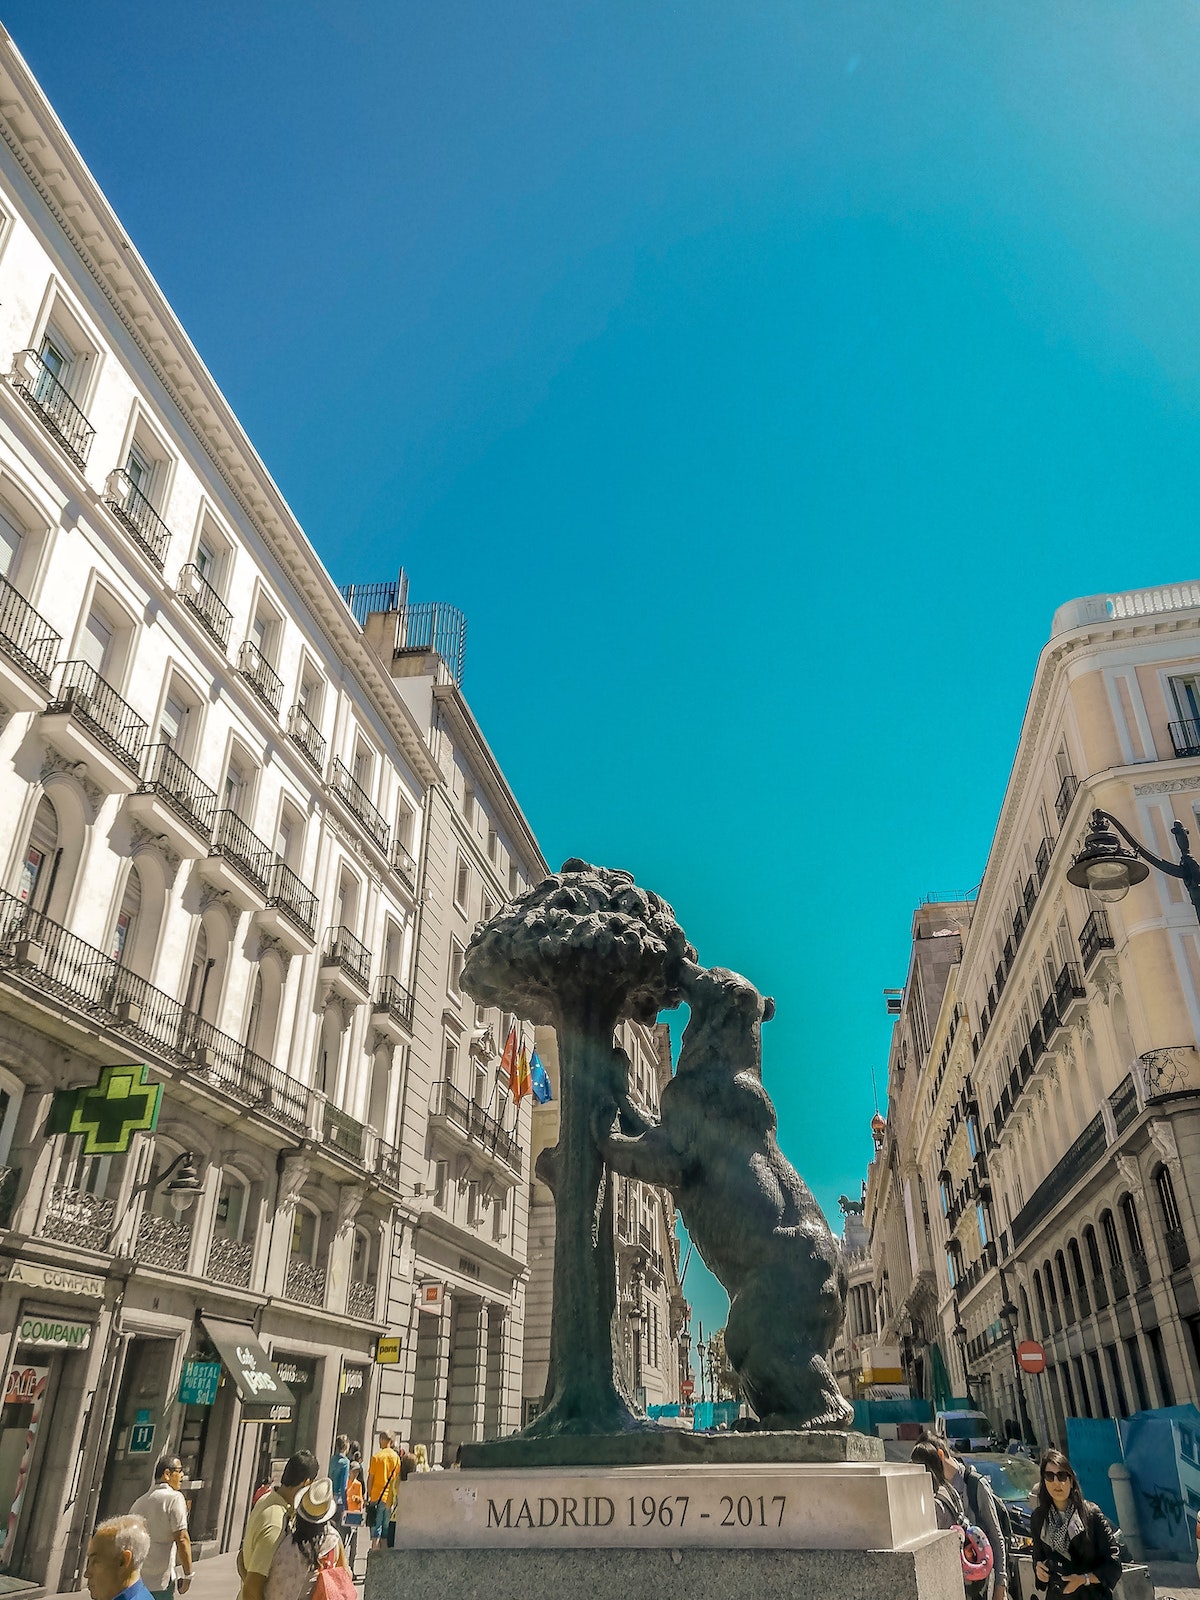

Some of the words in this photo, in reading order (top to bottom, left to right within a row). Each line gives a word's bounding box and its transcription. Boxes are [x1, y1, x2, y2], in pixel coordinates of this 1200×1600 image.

[43, 1271, 103, 1293] COMPAN
[21, 1320, 88, 1343] COMPANY
[379, 1345, 398, 1355] pans
[185, 1362, 217, 1379] HOSTAL
[183, 1376, 211, 1390] PUERTA
[485, 1496, 615, 1529] MADRID
[628, 1495, 690, 1527] 1967
[719, 1495, 787, 1528] 2017
